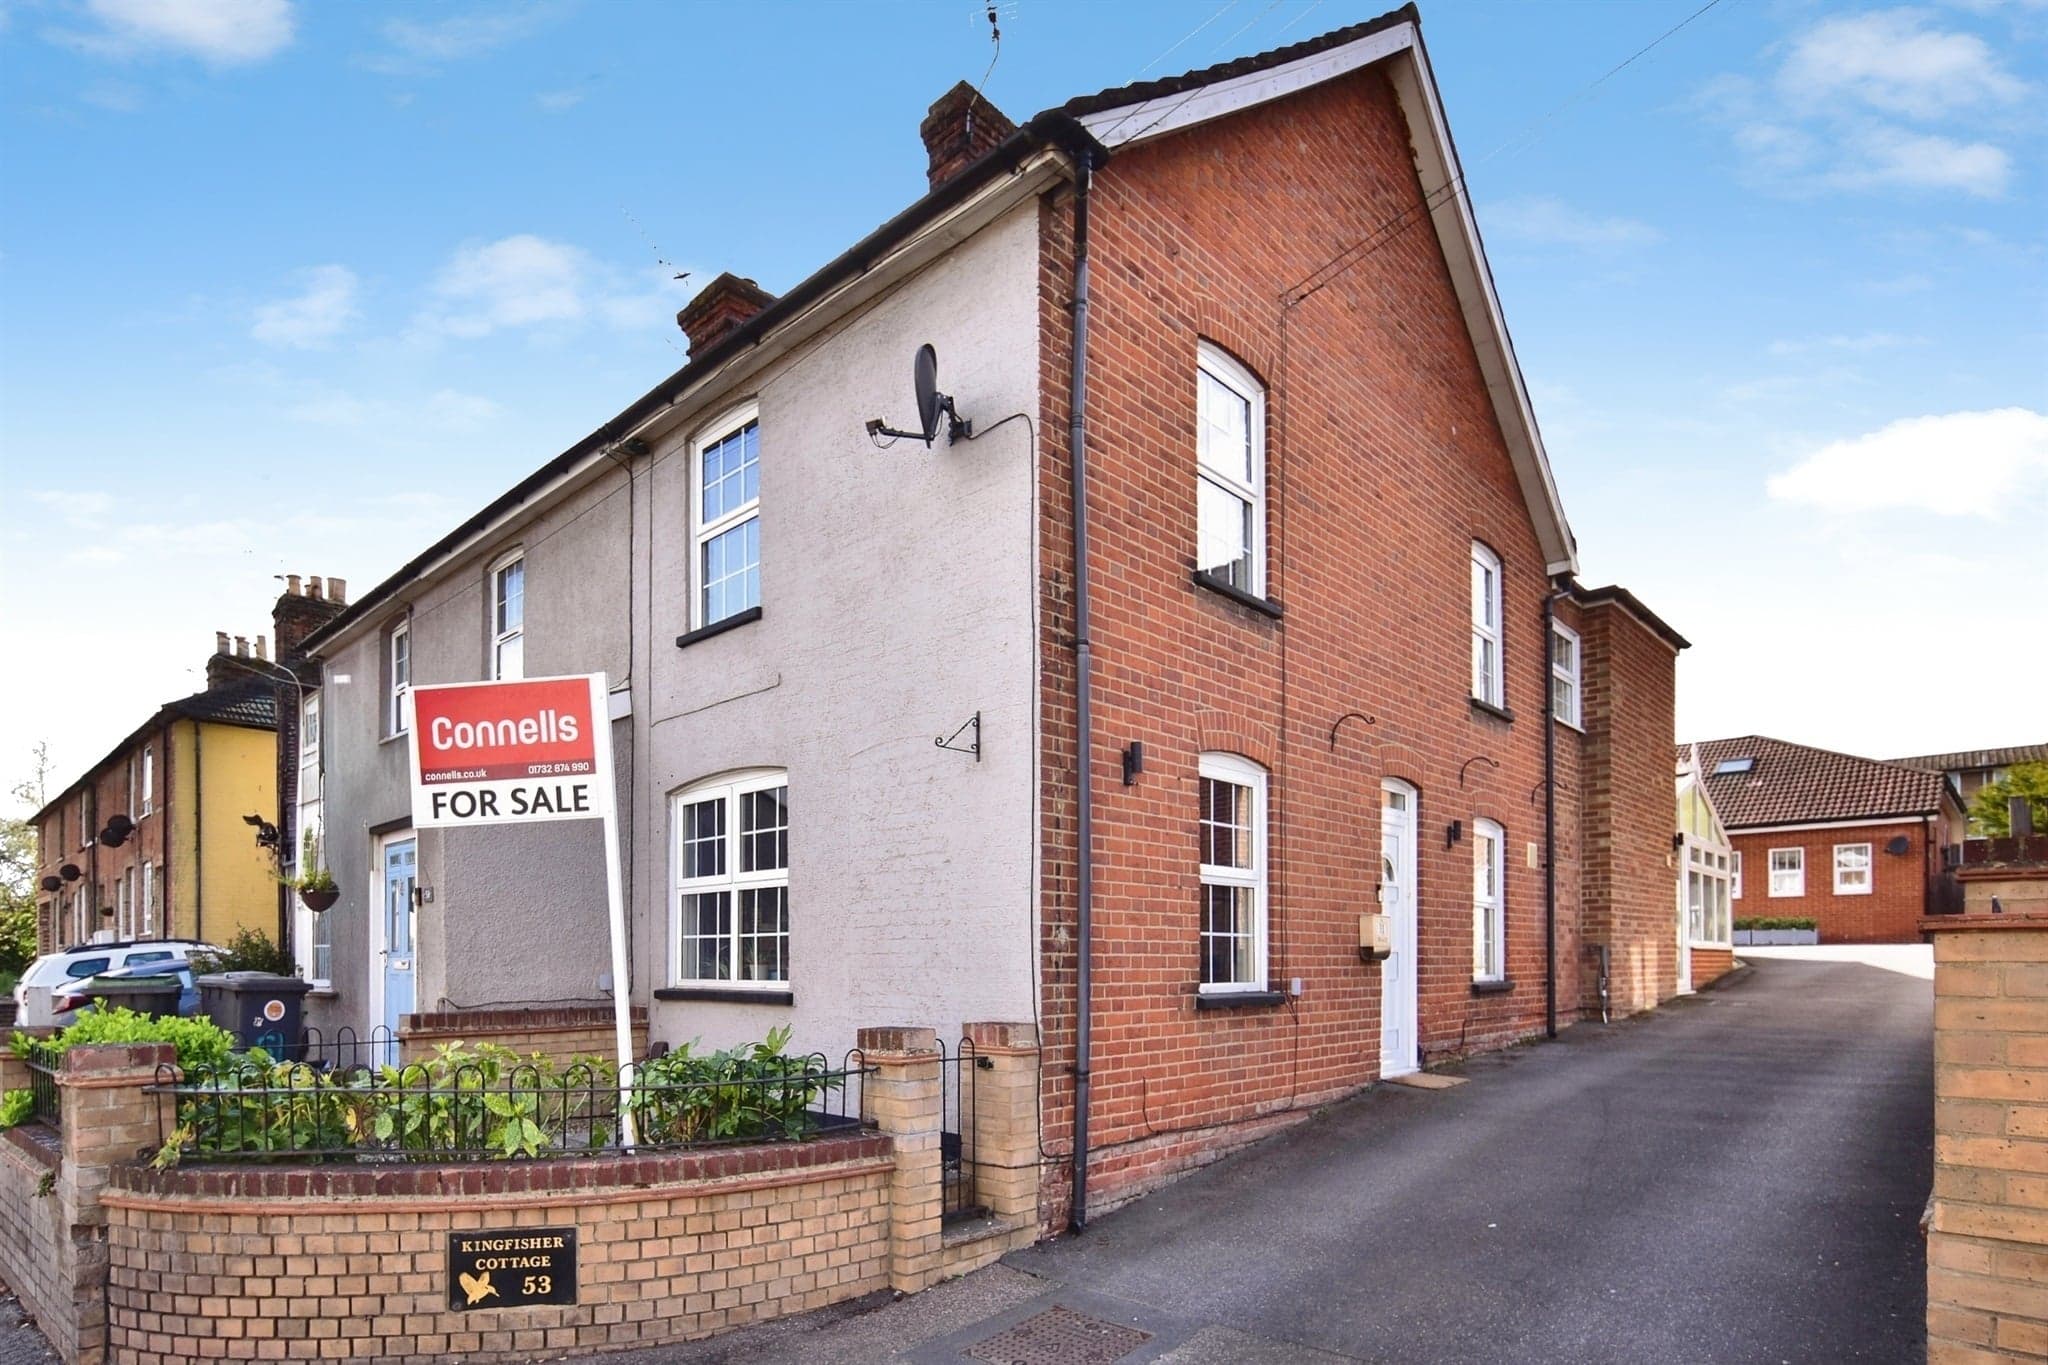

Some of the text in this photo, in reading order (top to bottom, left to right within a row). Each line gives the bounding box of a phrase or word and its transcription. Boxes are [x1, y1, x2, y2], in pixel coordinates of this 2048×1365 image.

[431, 709, 579, 750] Connells
[425, 768, 487, 781] connells.co.uk
[528, 762, 589, 774] 01732 874 990
[432, 784, 590, 819] FOR SALE
[461, 1236, 564, 1252] KINGFISHER
[475, 1256, 551, 1270] COTTAGE
[522, 1275, 552, 1295] 53
